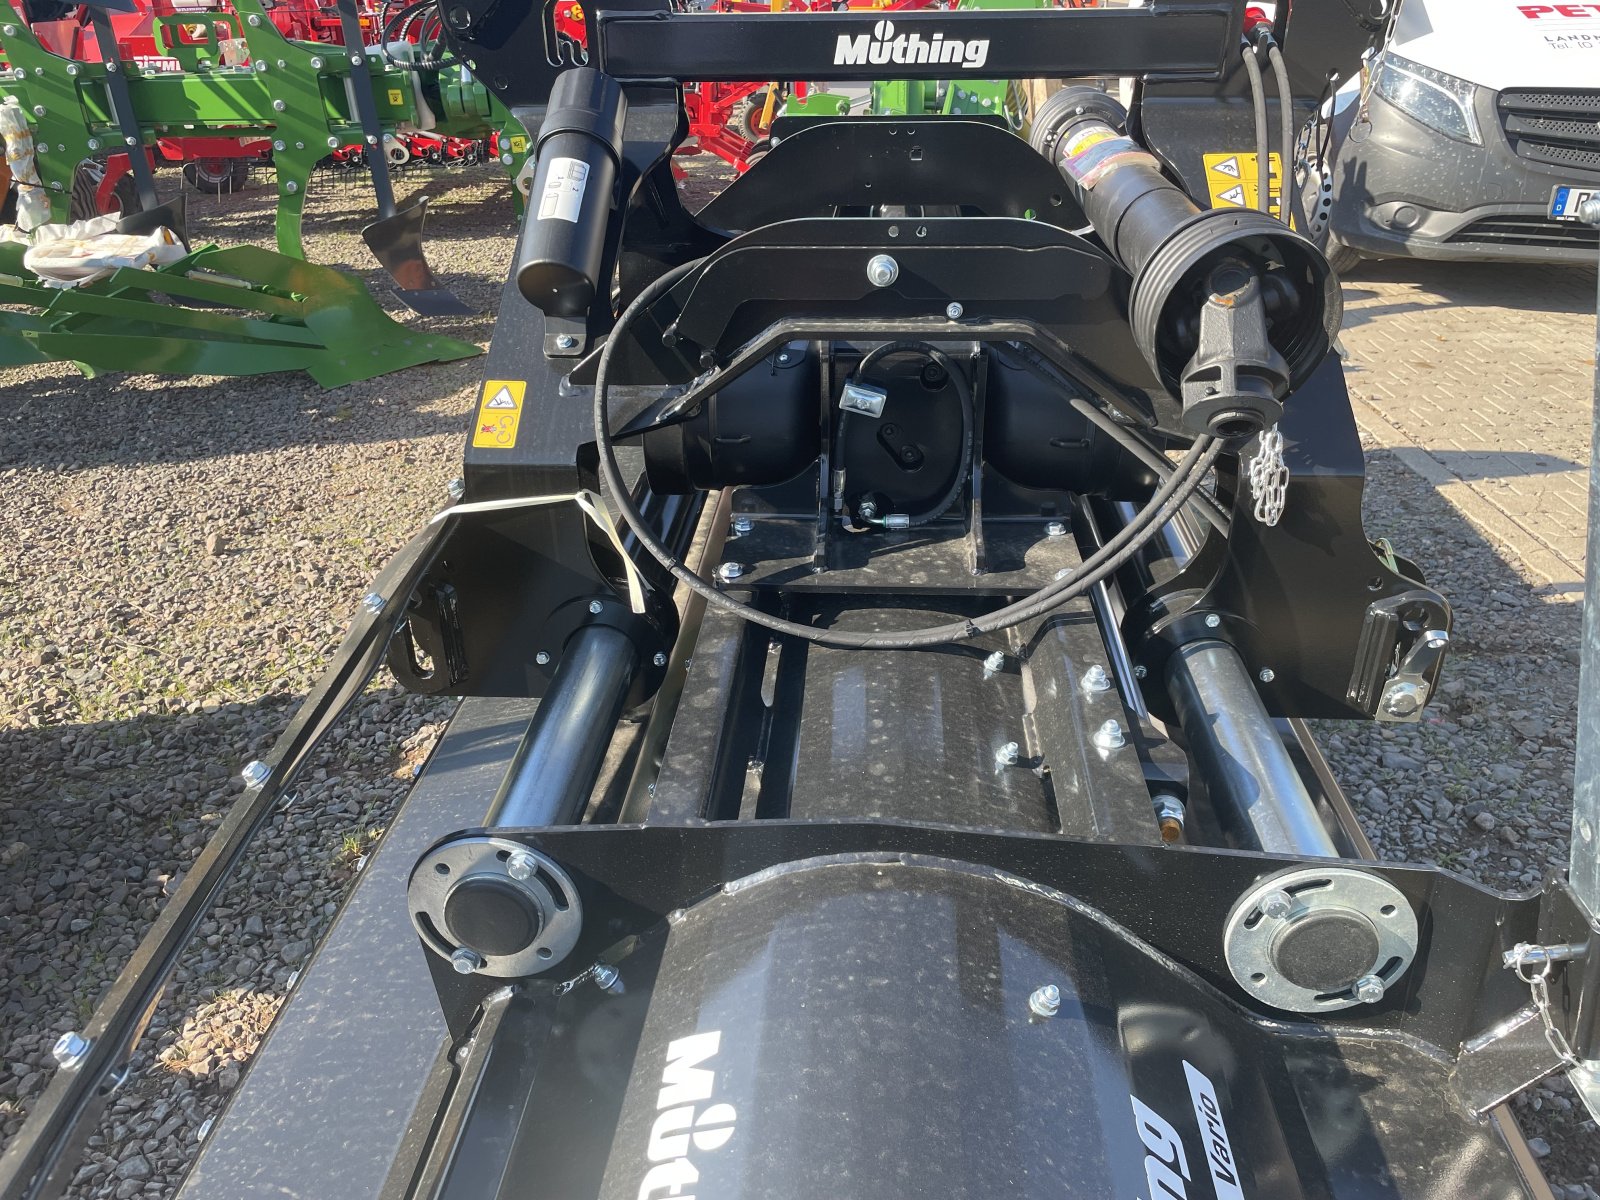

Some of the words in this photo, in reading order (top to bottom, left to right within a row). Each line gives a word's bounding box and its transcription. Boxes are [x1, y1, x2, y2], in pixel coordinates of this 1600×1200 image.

[833, 20, 990, 69] Müthing
[637, 1031, 737, 1200] Müt
[1198, 1092, 1237, 1187] Vario
